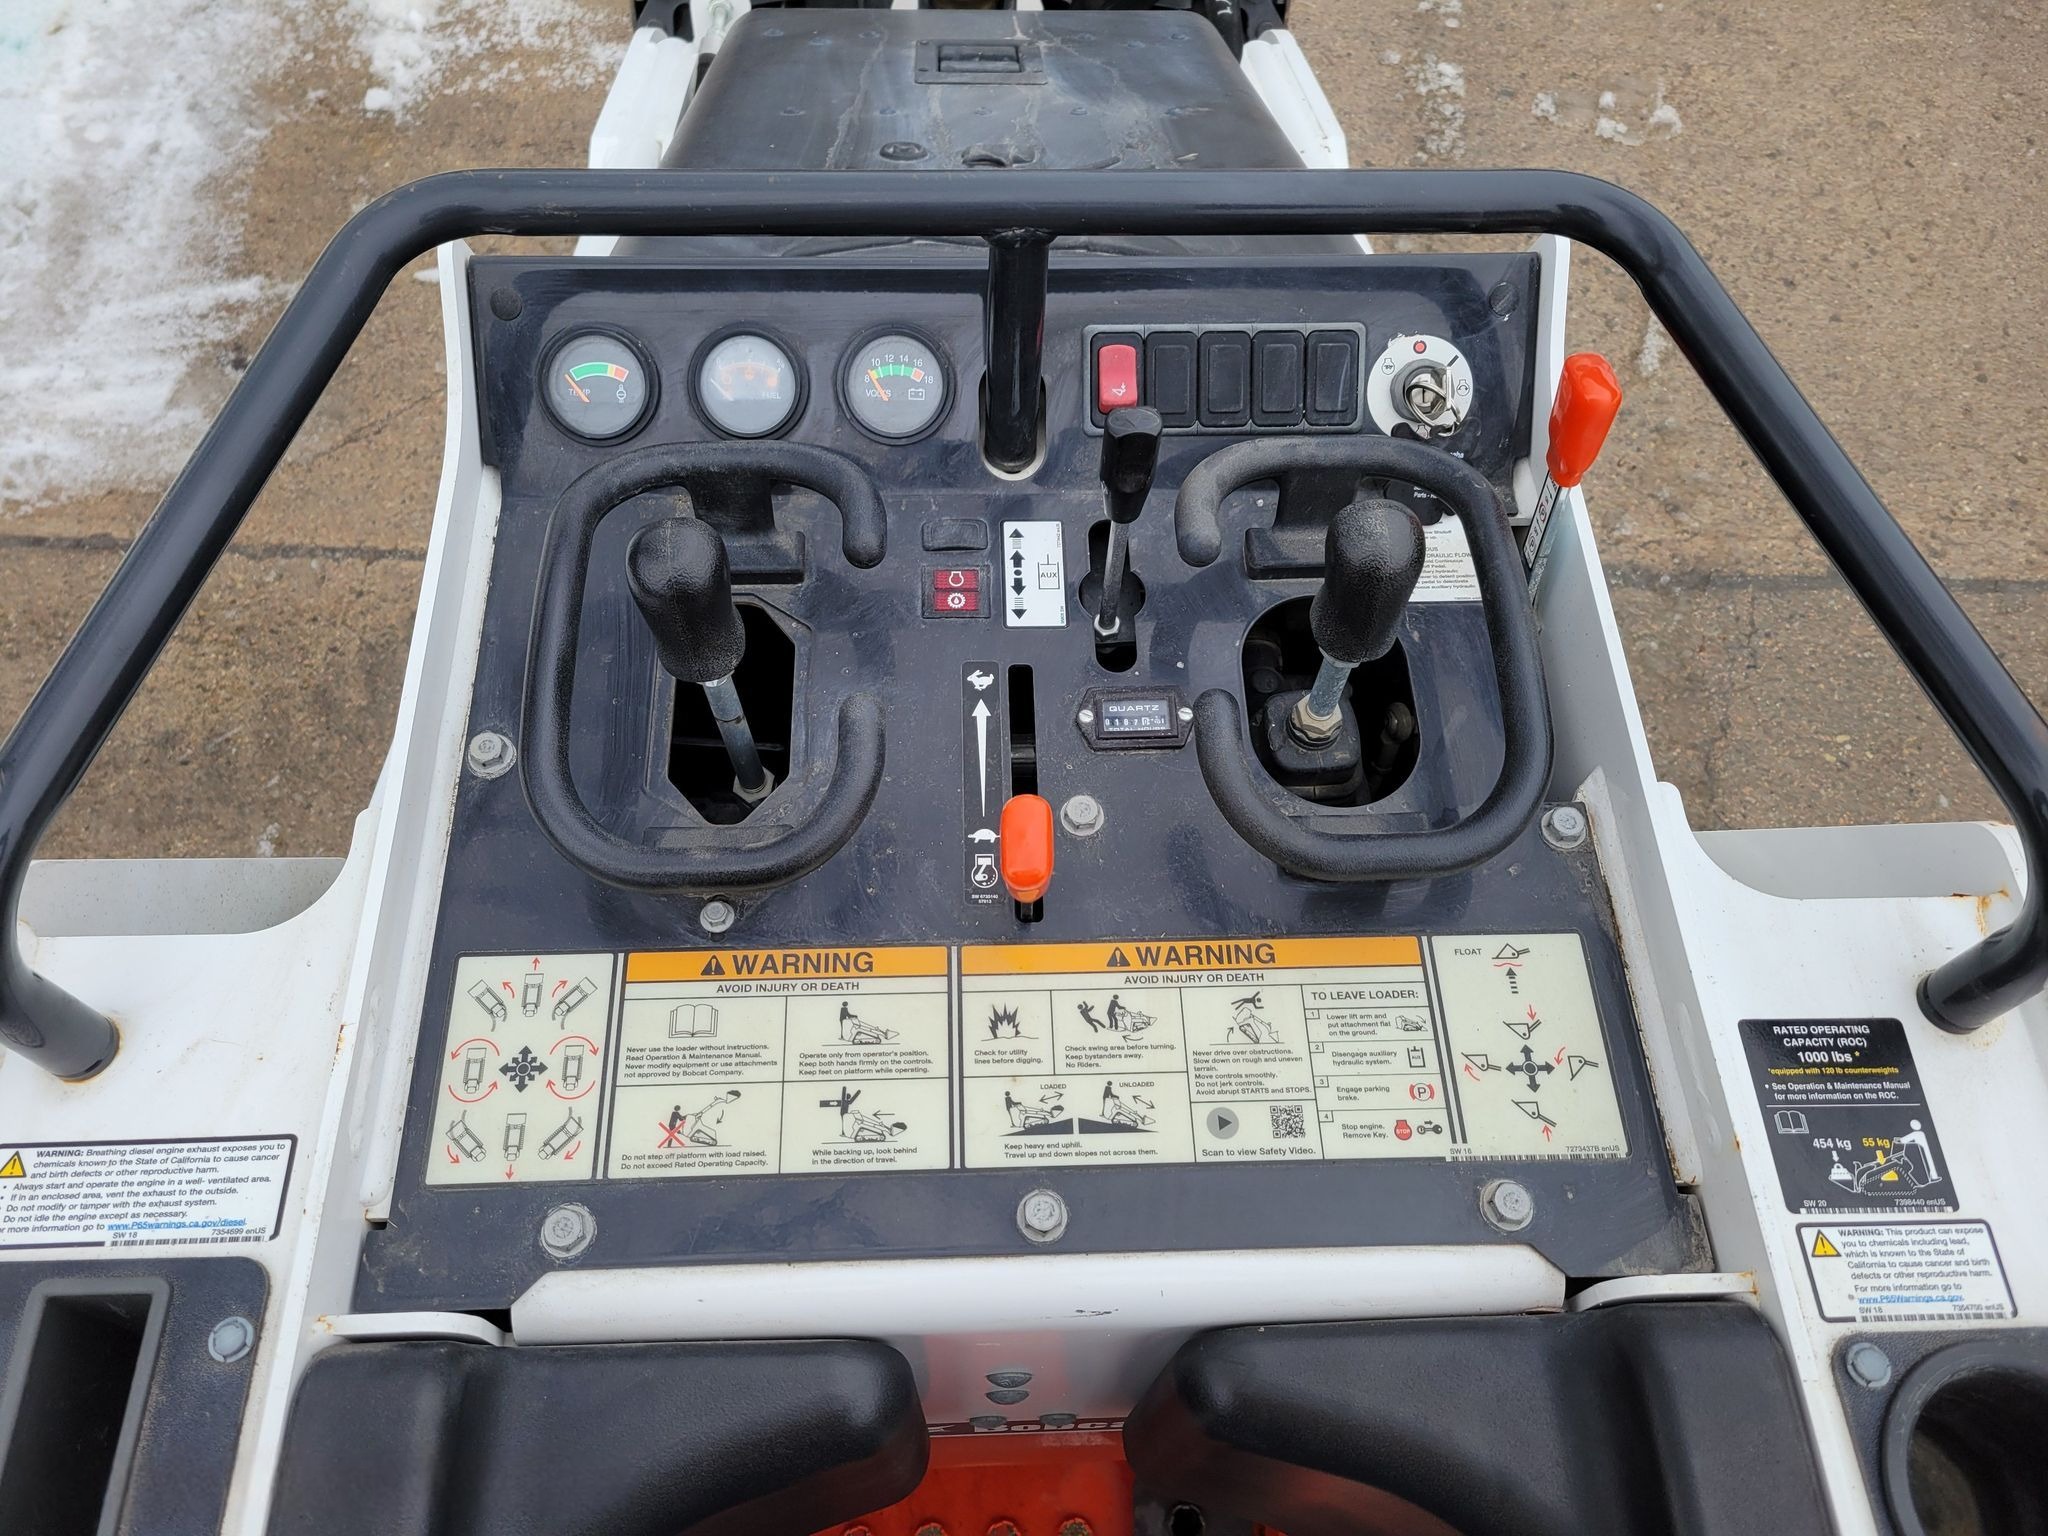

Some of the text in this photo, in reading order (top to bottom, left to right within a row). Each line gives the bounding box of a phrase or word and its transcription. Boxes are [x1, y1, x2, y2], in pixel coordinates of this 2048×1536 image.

[1135, 943, 1275, 966] WARNING
[731, 951, 873, 975] WARNING
[1124, 972, 1264, 984] AVOID INJURY OR DEATH
[716, 981, 859, 993] AVOID INJURY OR DEATH
[1310, 990, 1418, 1000] TO LEAVE LOADER:
[1773, 1025, 1869, 1034] RATED OPERATING
[1783, 1037, 1866, 1047] CAPACITY (ROC)
[1797, 1051, 1852, 1062] 1000 lbs
[1787, 1082, 1825, 1091] Operation
[1417, 1087, 1426, 1098] P
[1812, 1138, 1851, 1151] 454 kg
[1862, 1138, 1892, 1149] 55 kg
[36, 1149, 84, 1157] WARNING:
[86, 1148, 126, 1156] Breathing
[155, 1146, 184, 1155] engine
[1259, 1147, 1286, 1156] Safety
[67, 1213, 97, 1222] engine
[98, 1212, 128, 1220] except
[142, 1211, 187, 1220] necessary.
[1837, 1228, 1883, 1236] WARNING:
[1904, 1228, 1935, 1236] product
